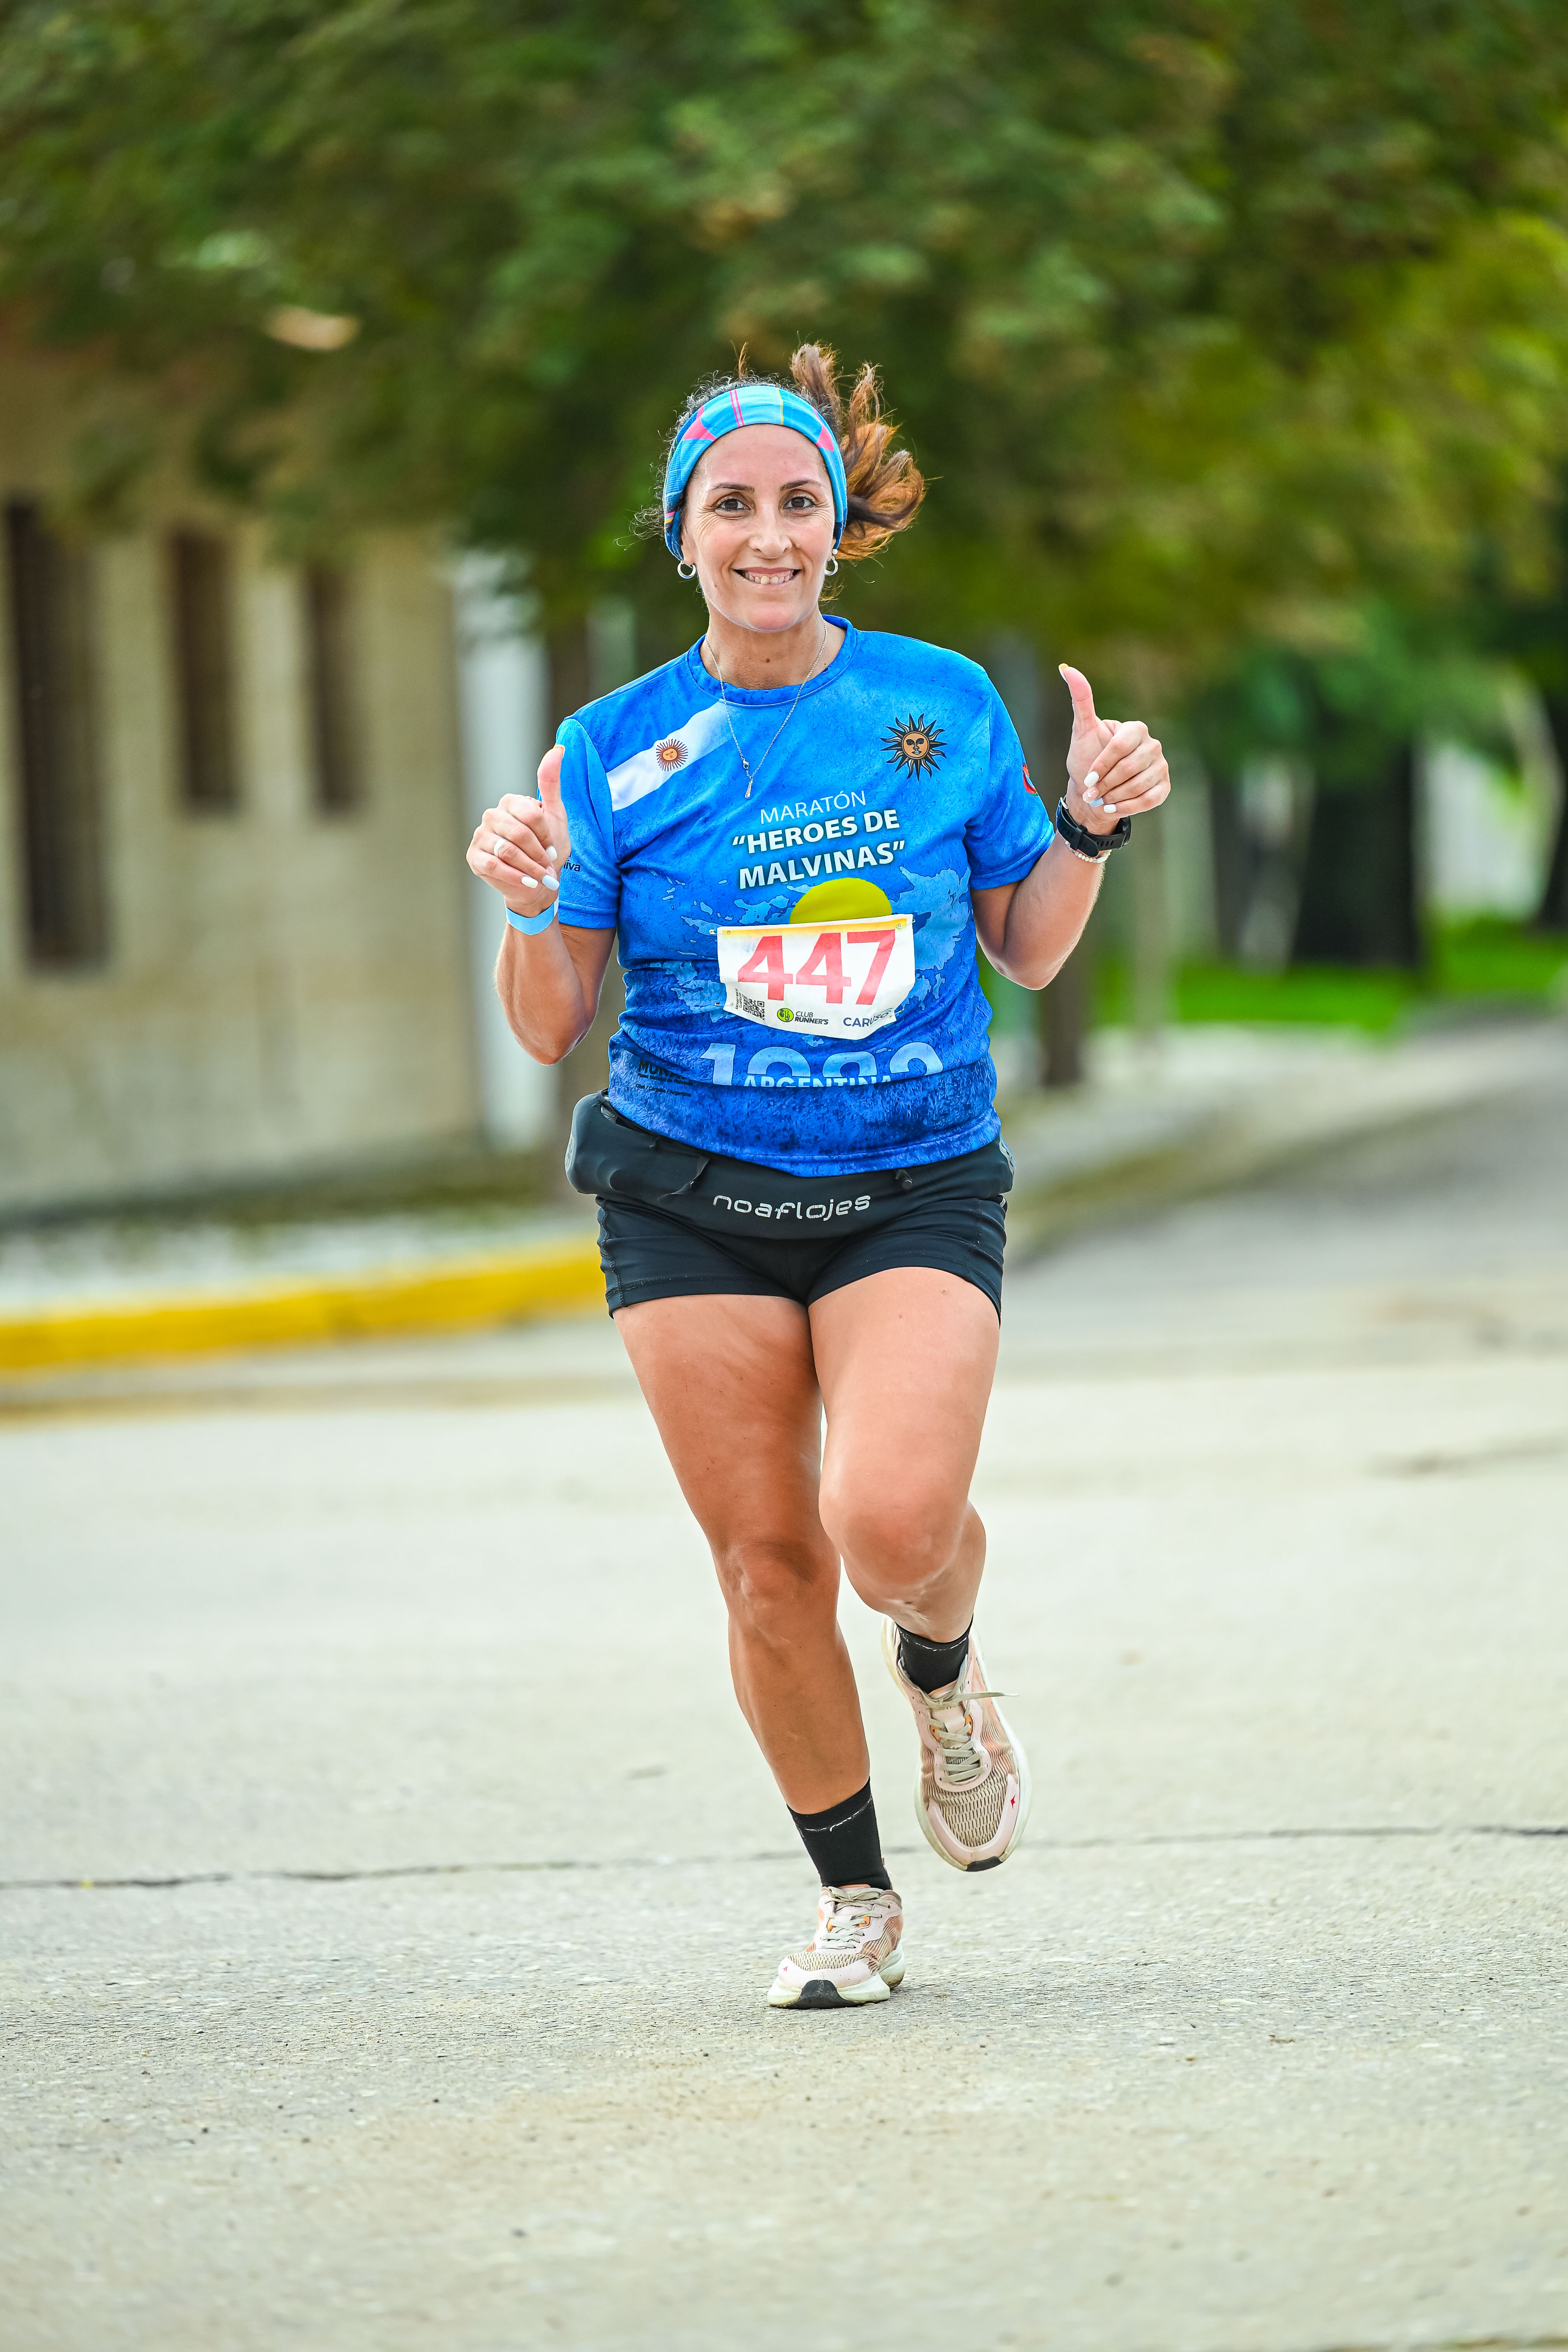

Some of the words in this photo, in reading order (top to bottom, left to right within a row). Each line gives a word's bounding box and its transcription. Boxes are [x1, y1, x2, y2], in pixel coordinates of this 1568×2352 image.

[760, 790, 866, 824] MARATÓN
[864, 809, 900, 833] DE
[738, 929, 895, 1005] 447
[794, 1017, 829, 1025] RUNNER'S
[843, 1012, 889, 1027] CARUSO
[713, 1195, 871, 1221] noaflojes
